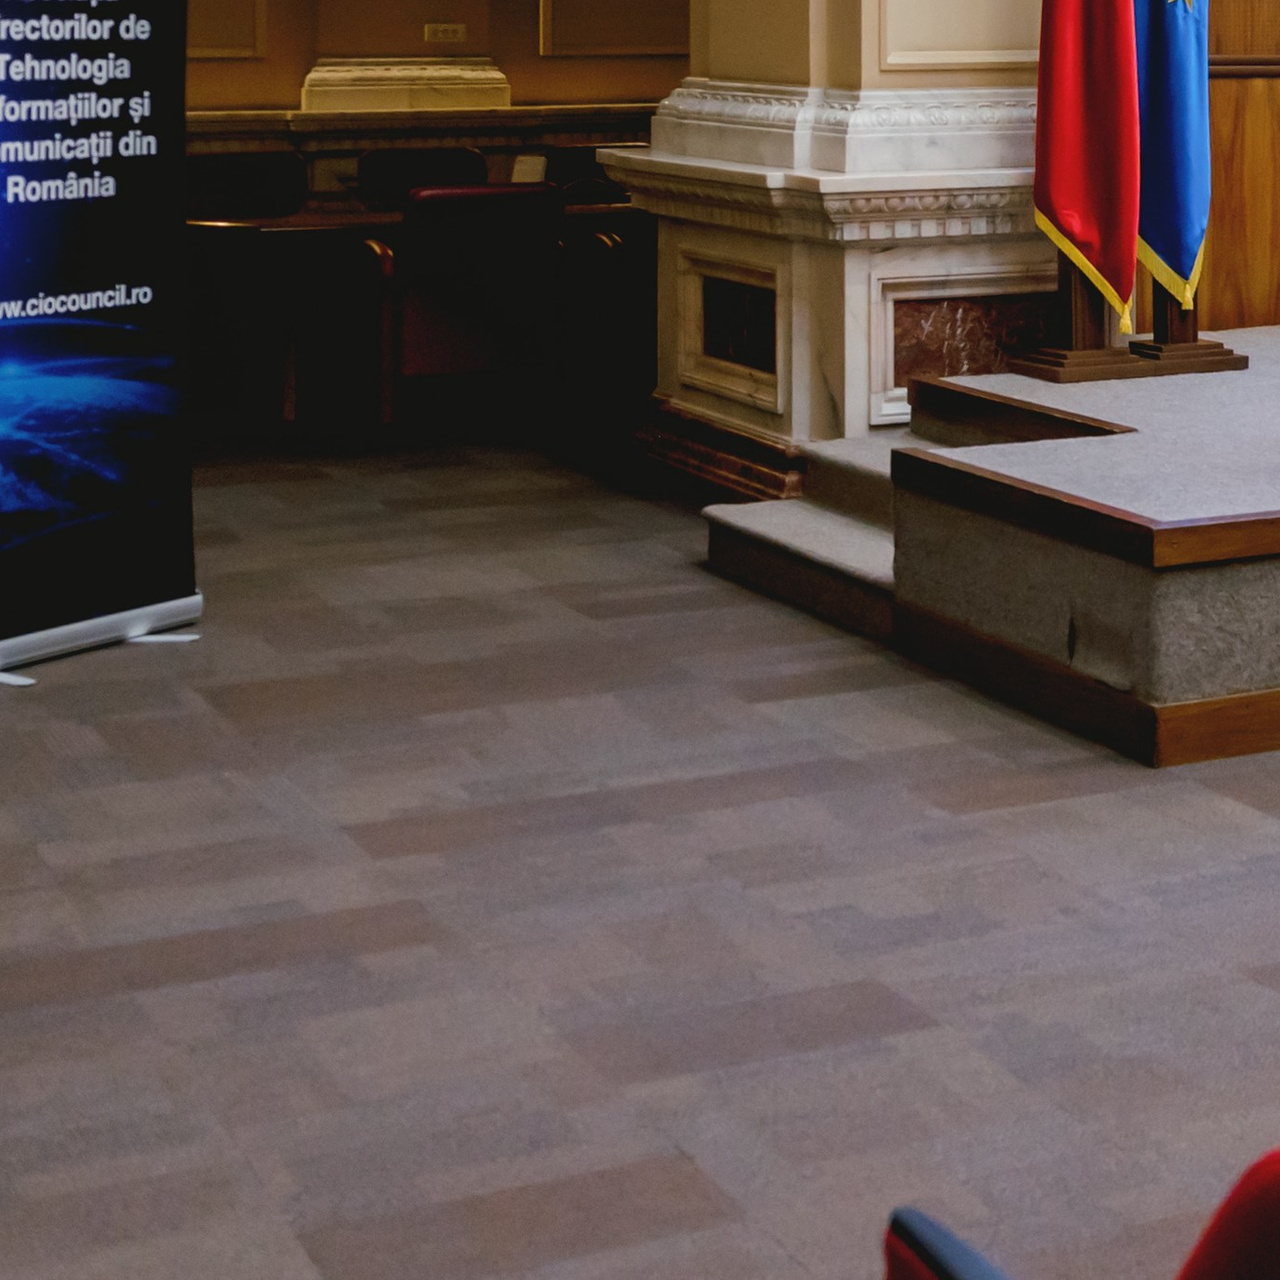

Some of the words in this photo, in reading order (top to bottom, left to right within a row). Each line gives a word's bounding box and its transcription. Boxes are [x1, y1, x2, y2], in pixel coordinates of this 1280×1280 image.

[0, 13, 114, 40] rectorilor
[119, 13, 152, 40] de
[129, 90, 151, 124] și
[0, 131, 113, 165] municații
[118, 130, 157, 157] din
[6, 171, 116, 203] România
